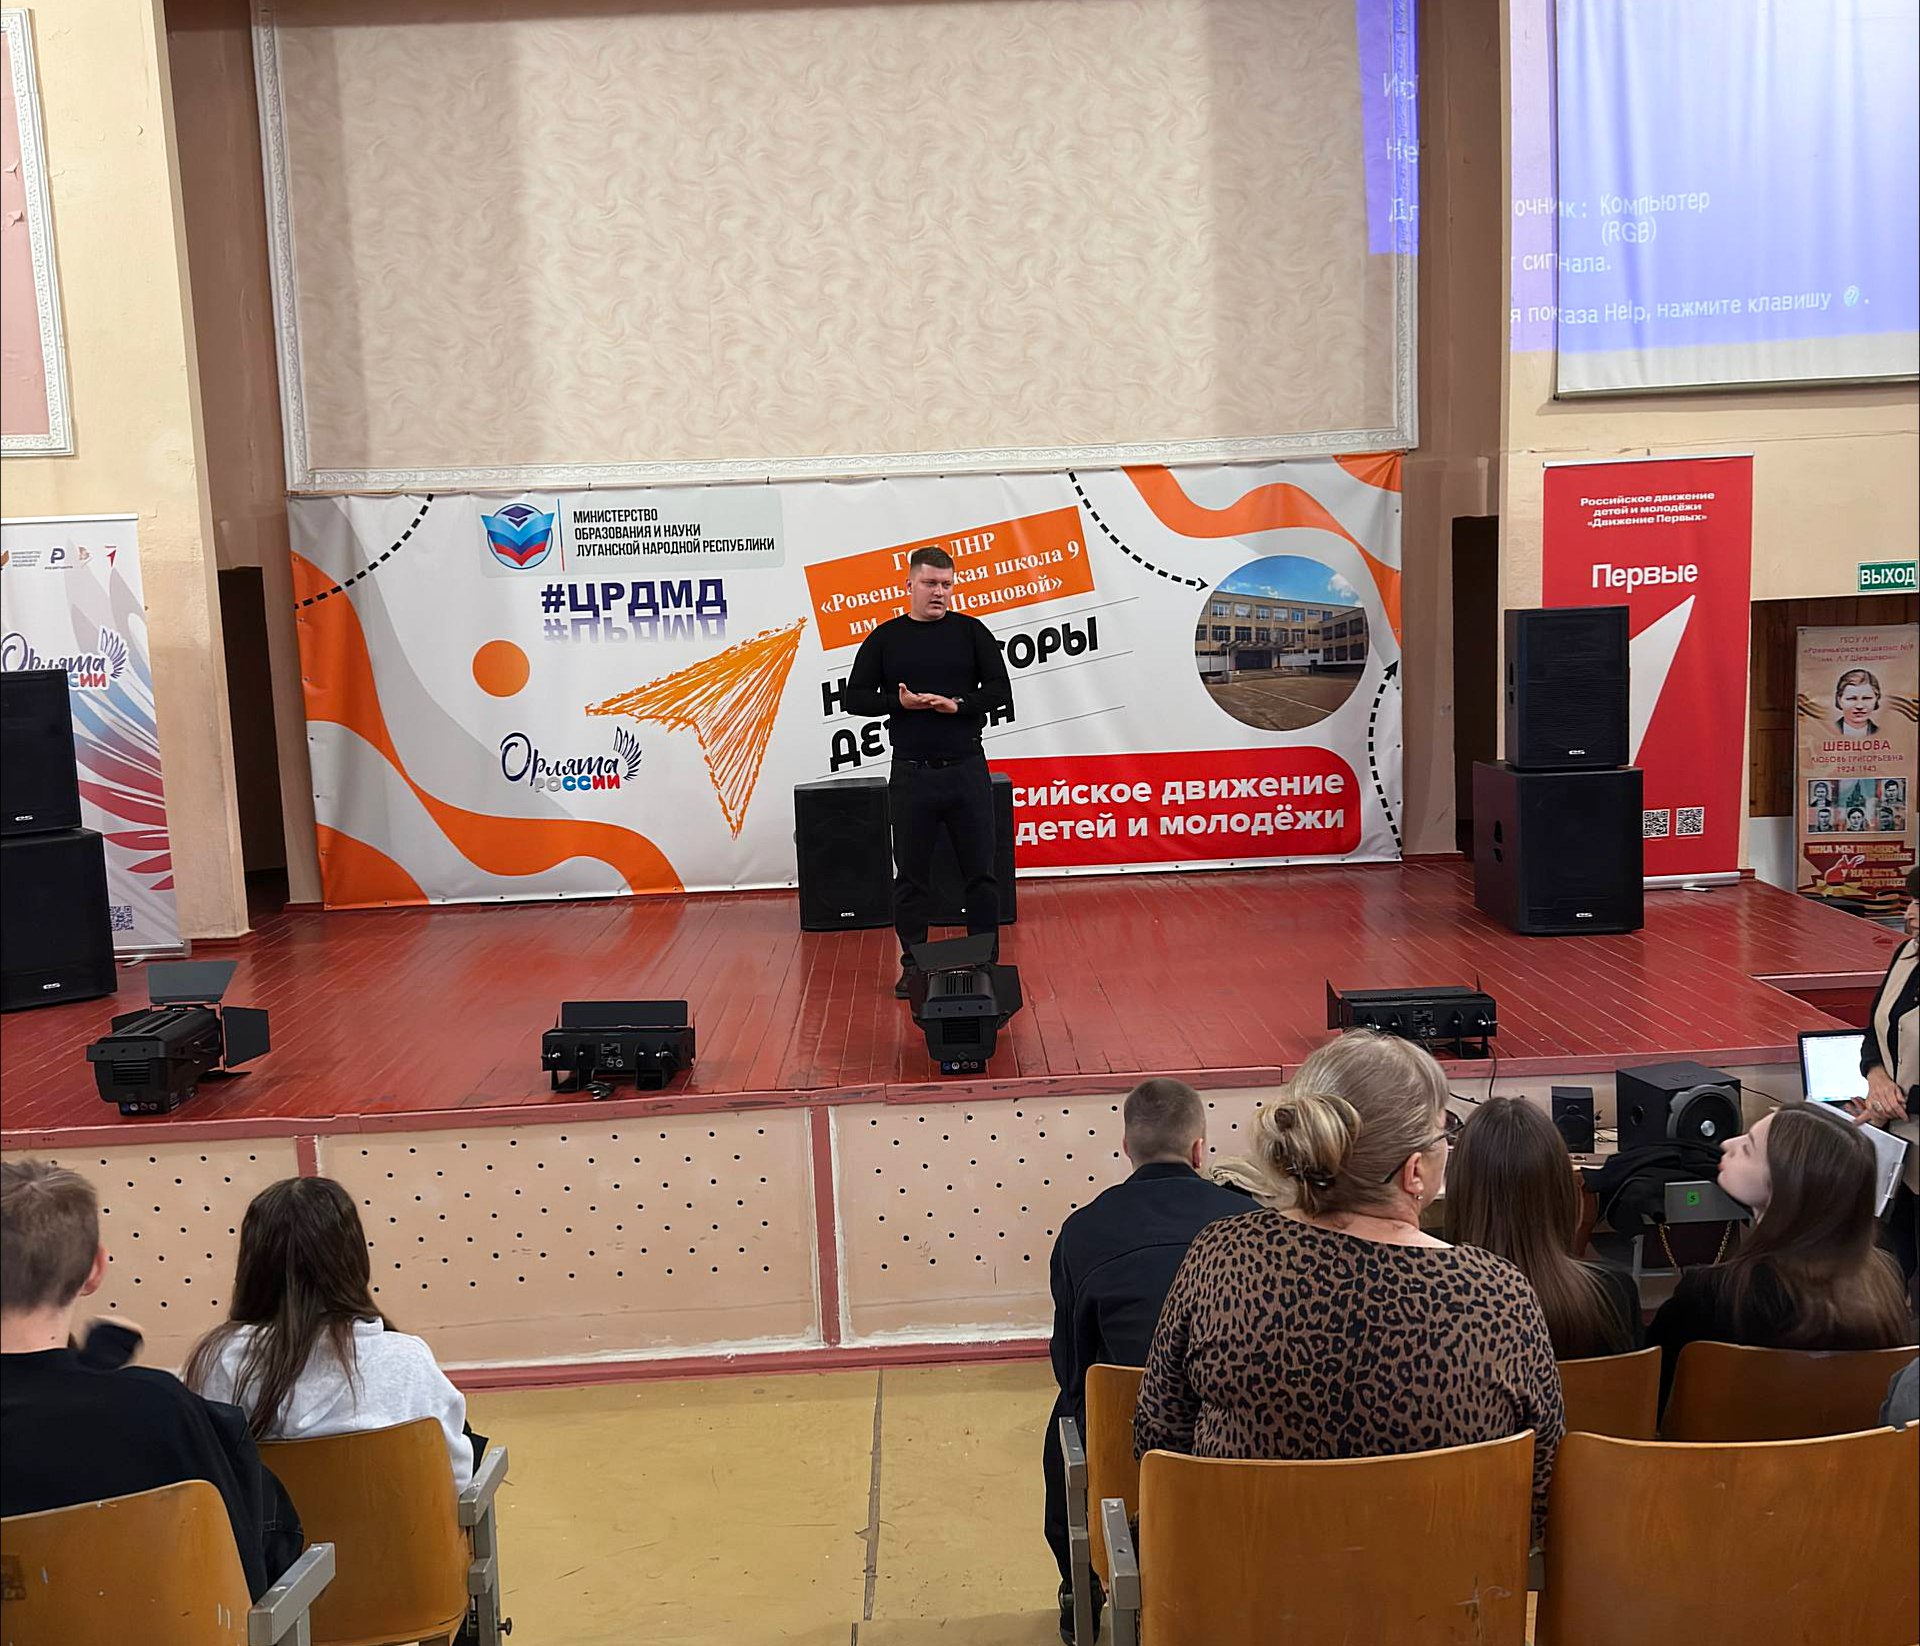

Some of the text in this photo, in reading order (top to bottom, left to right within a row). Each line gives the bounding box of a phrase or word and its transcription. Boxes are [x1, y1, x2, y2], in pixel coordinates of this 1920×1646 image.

[1600, 192, 1711, 216] Компьютер
[1601, 215, 1657, 246] (RGB)
[1522, 253, 1612, 273] сигнала.
[1528, 306, 1599, 324] показа
[1604, 301, 1651, 324] Help,
[1657, 298, 1742, 318] нажмите
[1747, 291, 1832, 313] клавишу
[1580, 491, 1715, 507] Российское движение
[573, 508, 658, 524] МИНИСТЕРСТВО
[1593, 502, 1702, 517] детей и молодёжи
[1587, 513, 1707, 528] «Движение Первых»
[574, 524, 701, 540] ОБРАЗОВАНИЯ И НАУКИ
[576, 537, 775, 557] ЛУГАНСКОЙ НАРОДНОЙ РЕСПУБЛИКИ
[949, 532, 995, 558] ЛНР
[820, 565, 989, 614] «Ровенькая
[995, 547, 1063, 576] школа
[1067, 540, 1080, 560] 9
[1592, 562, 1698, 593] Первые
[1861, 567, 1915, 585] ВЫХОД
[541, 579, 727, 619] #ЦРДМД
[68, 673, 107, 687] СИИ
[1823, 740, 1891, 752] ШЕВЦОВА
[500, 732, 621, 786] Орлята
[535, 773, 620, 793] РОССИИ
[1012, 773, 1344, 807] сийское движение
[1015, 804, 1344, 846] детей и молодёжи
